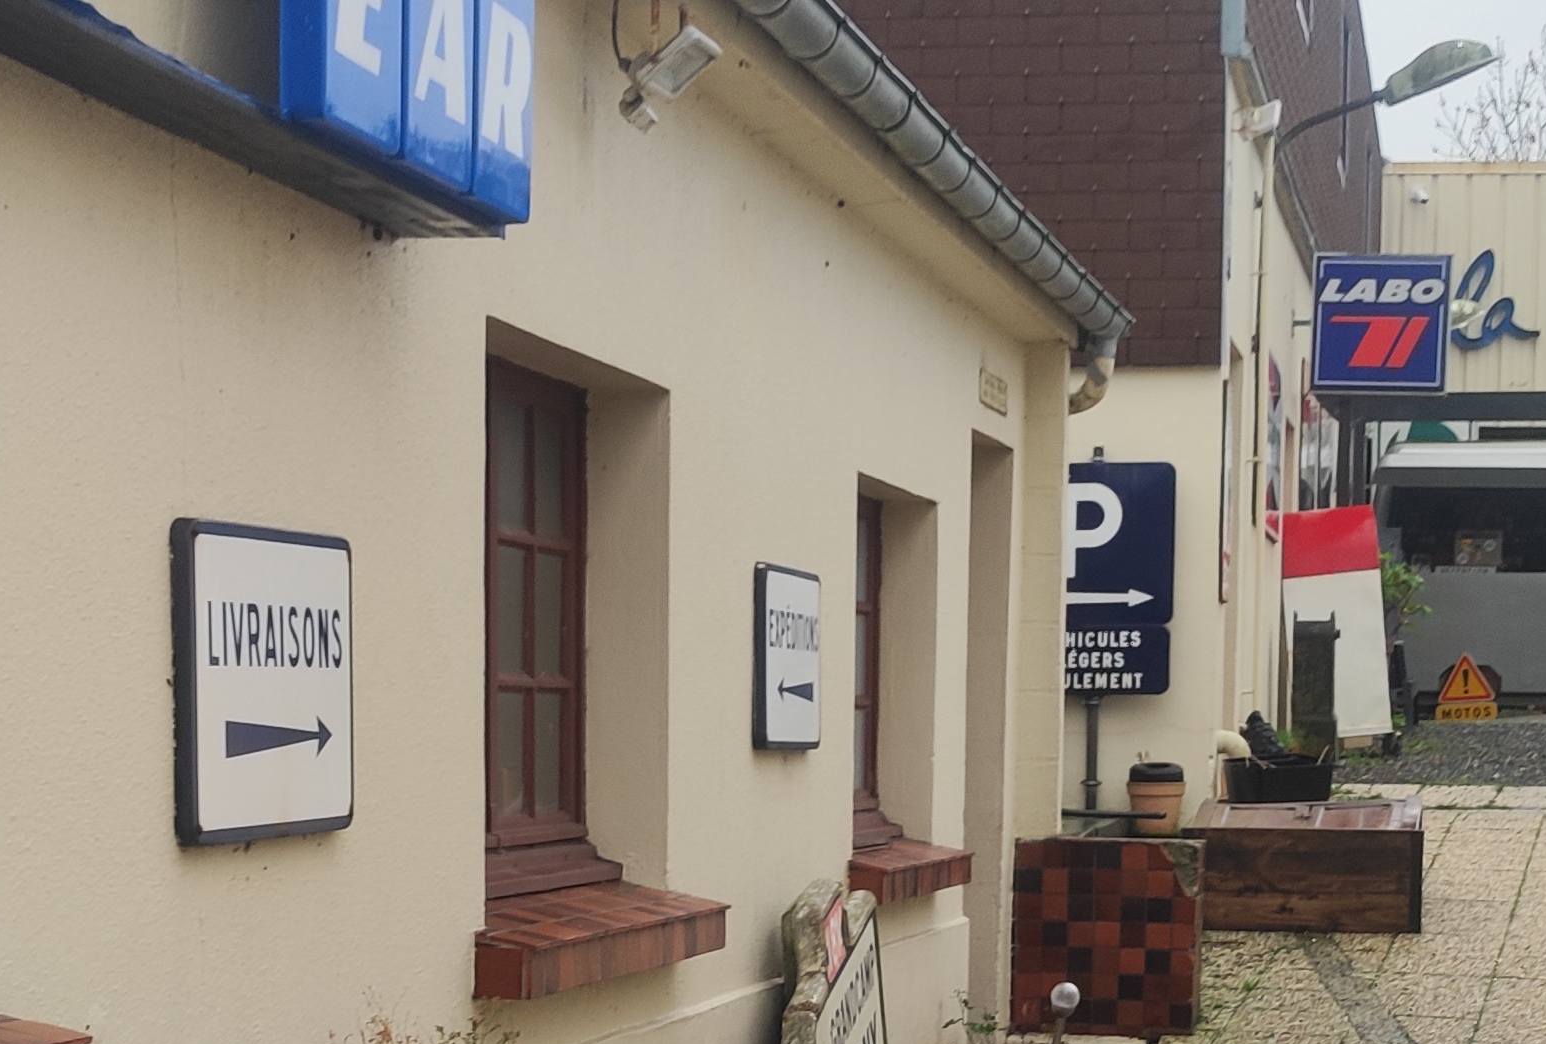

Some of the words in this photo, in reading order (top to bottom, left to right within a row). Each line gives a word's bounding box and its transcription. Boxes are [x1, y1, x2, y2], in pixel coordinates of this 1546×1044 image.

[1319, 278, 1445, 304] LABO
[1065, 482, 1123, 578] P
[208, 600, 342, 668] LIVRAISONS
[1065, 648, 1125, 669] ÉGERS
[1442, 706, 1492, 720] MOTOS
